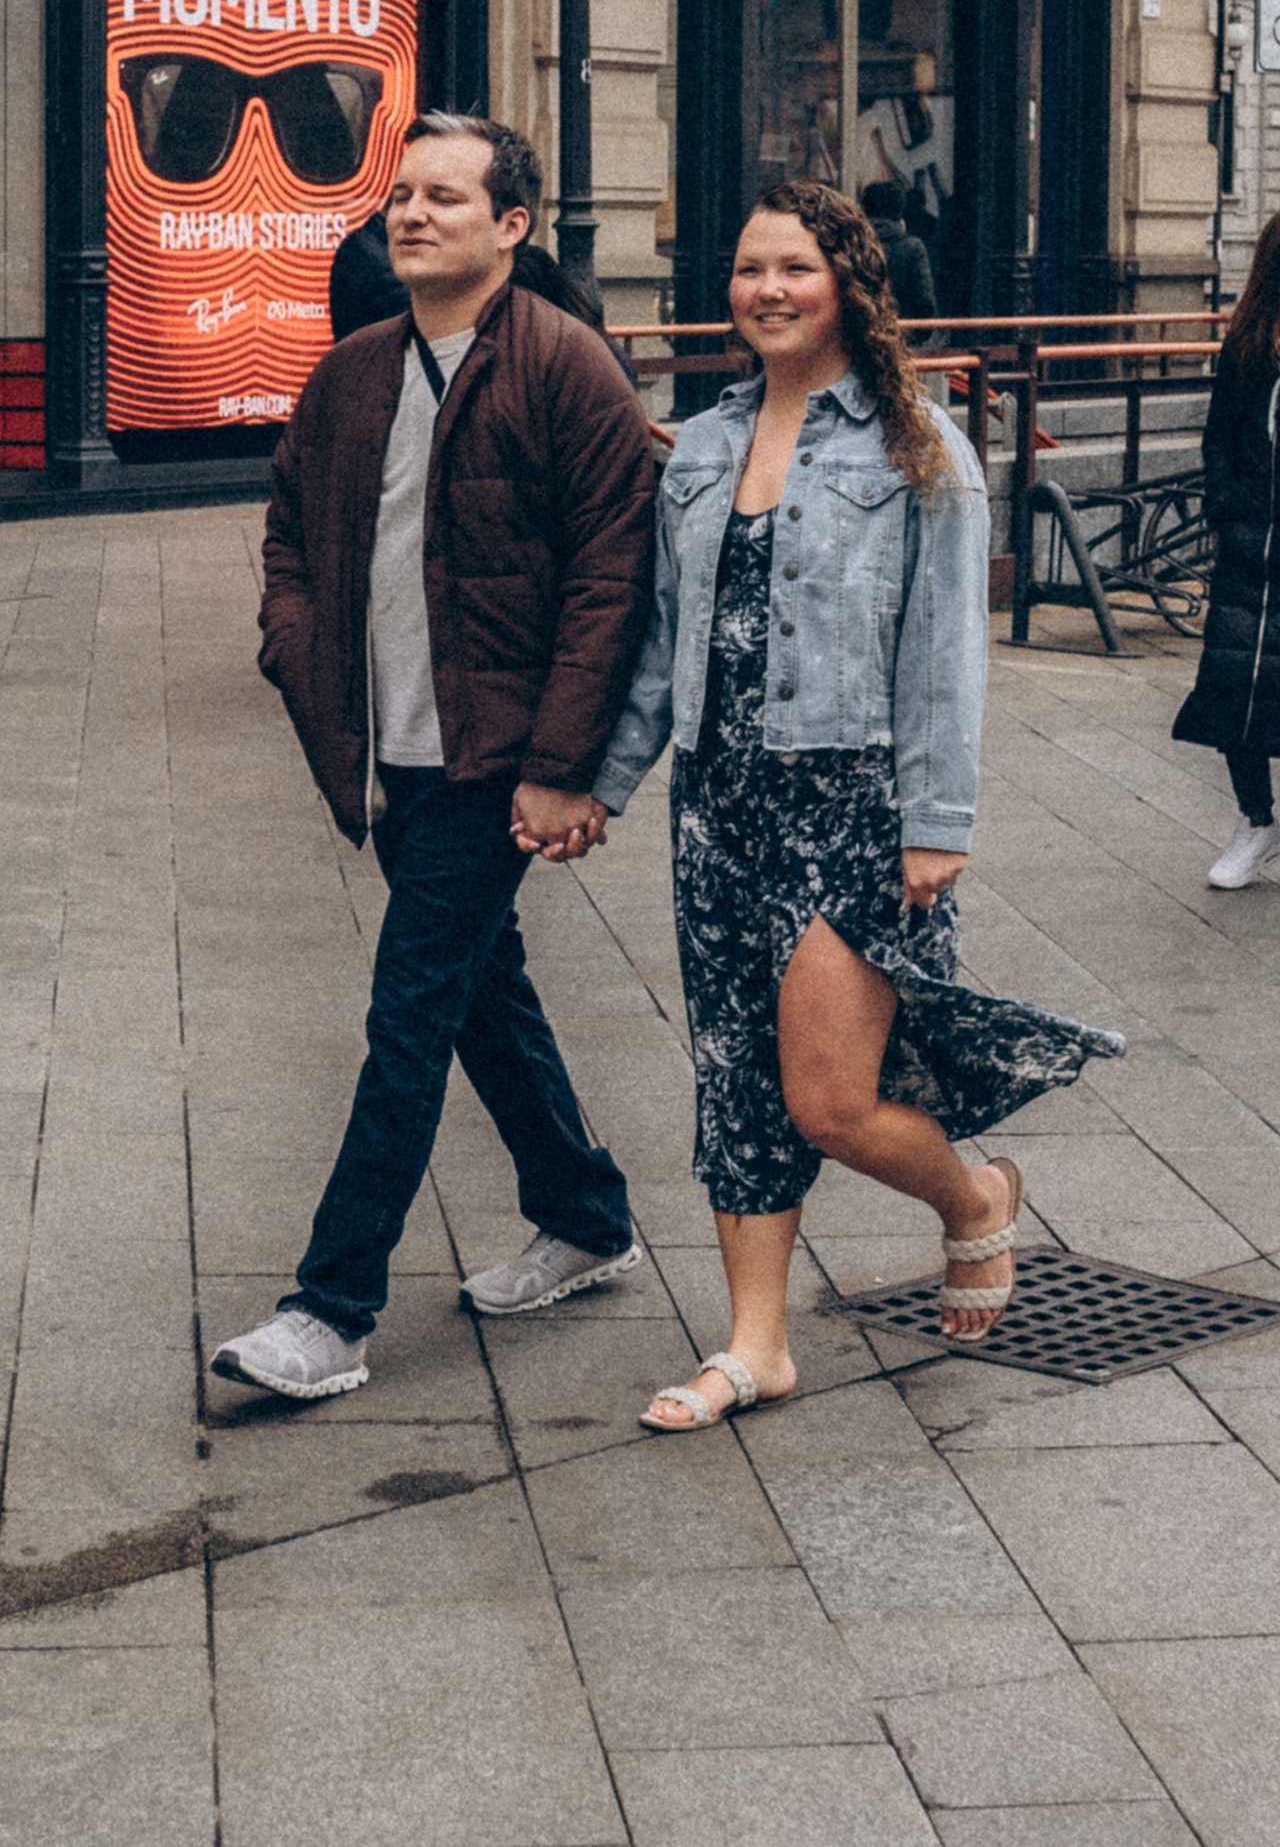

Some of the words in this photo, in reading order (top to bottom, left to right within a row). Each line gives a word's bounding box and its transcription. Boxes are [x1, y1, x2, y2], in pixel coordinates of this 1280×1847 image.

[160, 211, 254, 250] RAY-BAN
[259, 212, 347, 250] STORIES
[288, 301, 326, 319] Meta
